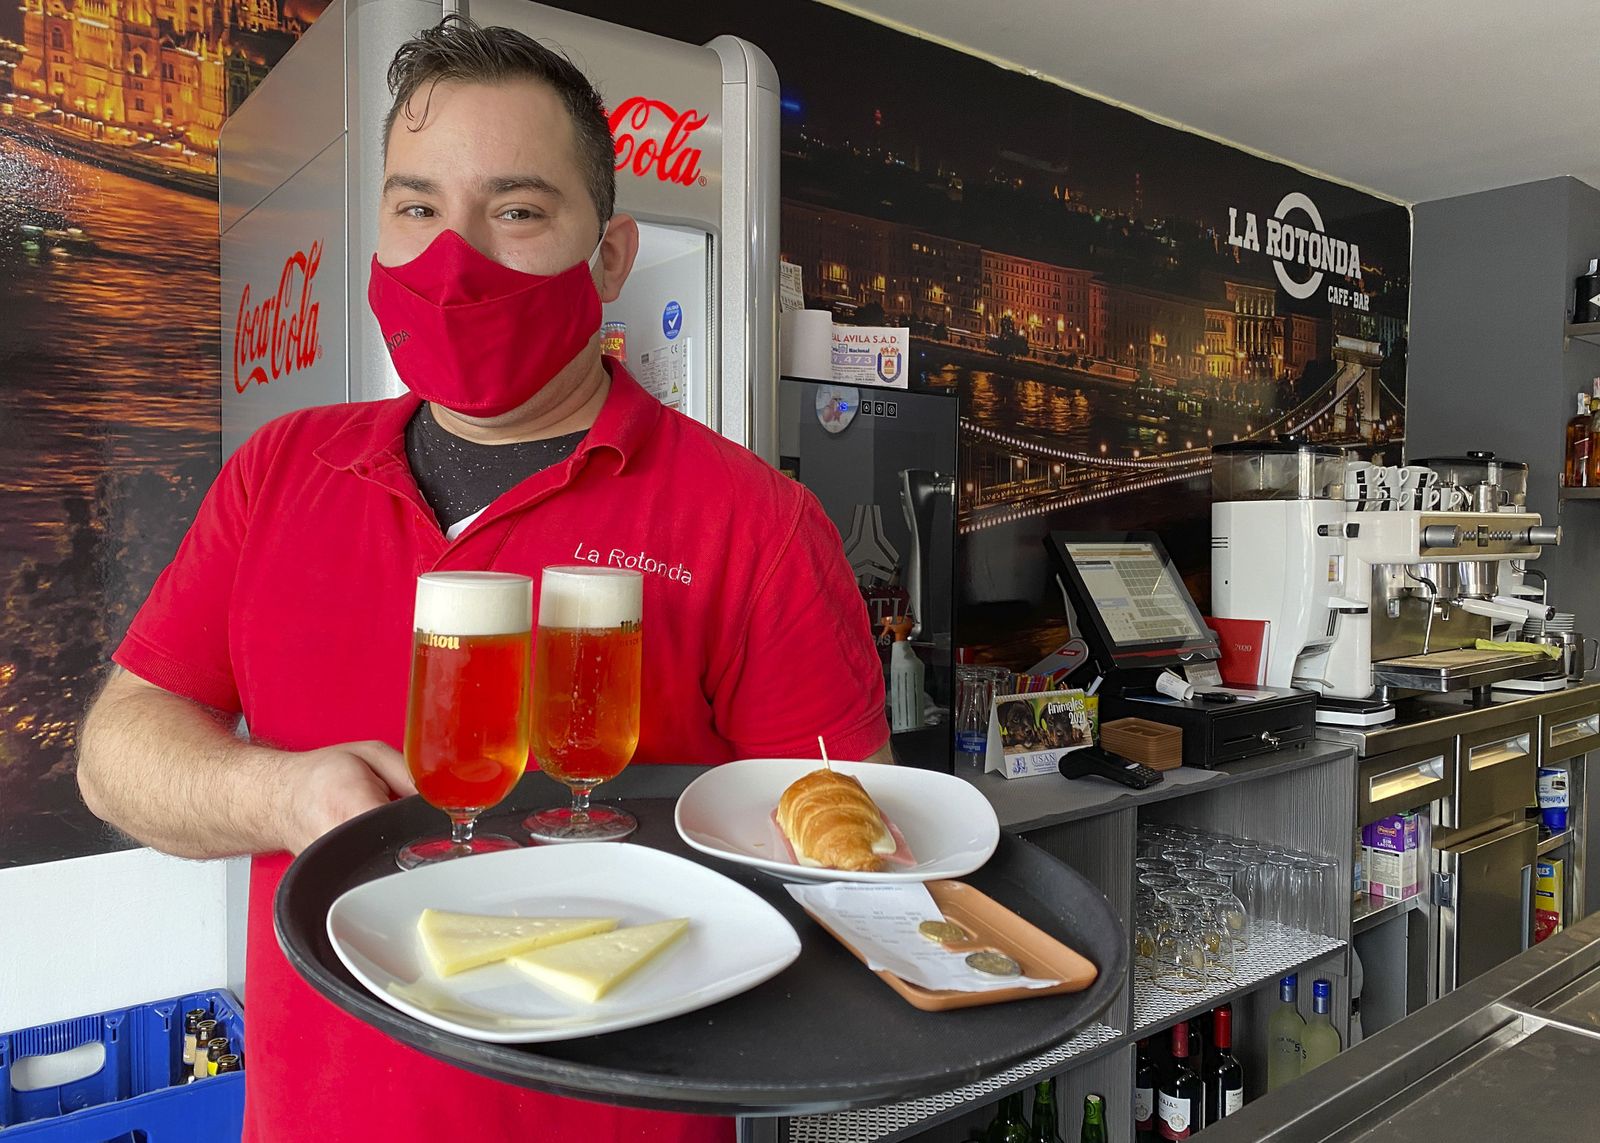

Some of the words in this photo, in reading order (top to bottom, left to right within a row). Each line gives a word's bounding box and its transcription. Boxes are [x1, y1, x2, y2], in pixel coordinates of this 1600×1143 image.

[1228, 206, 1260, 252] LA
[1265, 218, 1362, 279] ROTONDA
[843, 334, 871, 344] AVILA
[574, 542, 600, 563] La
[608, 548, 692, 585] Rotonda
[1233, 643, 1252, 652] 2020
[1047, 697, 1084, 715] Animales
[1068, 711, 1086, 726] 2021
